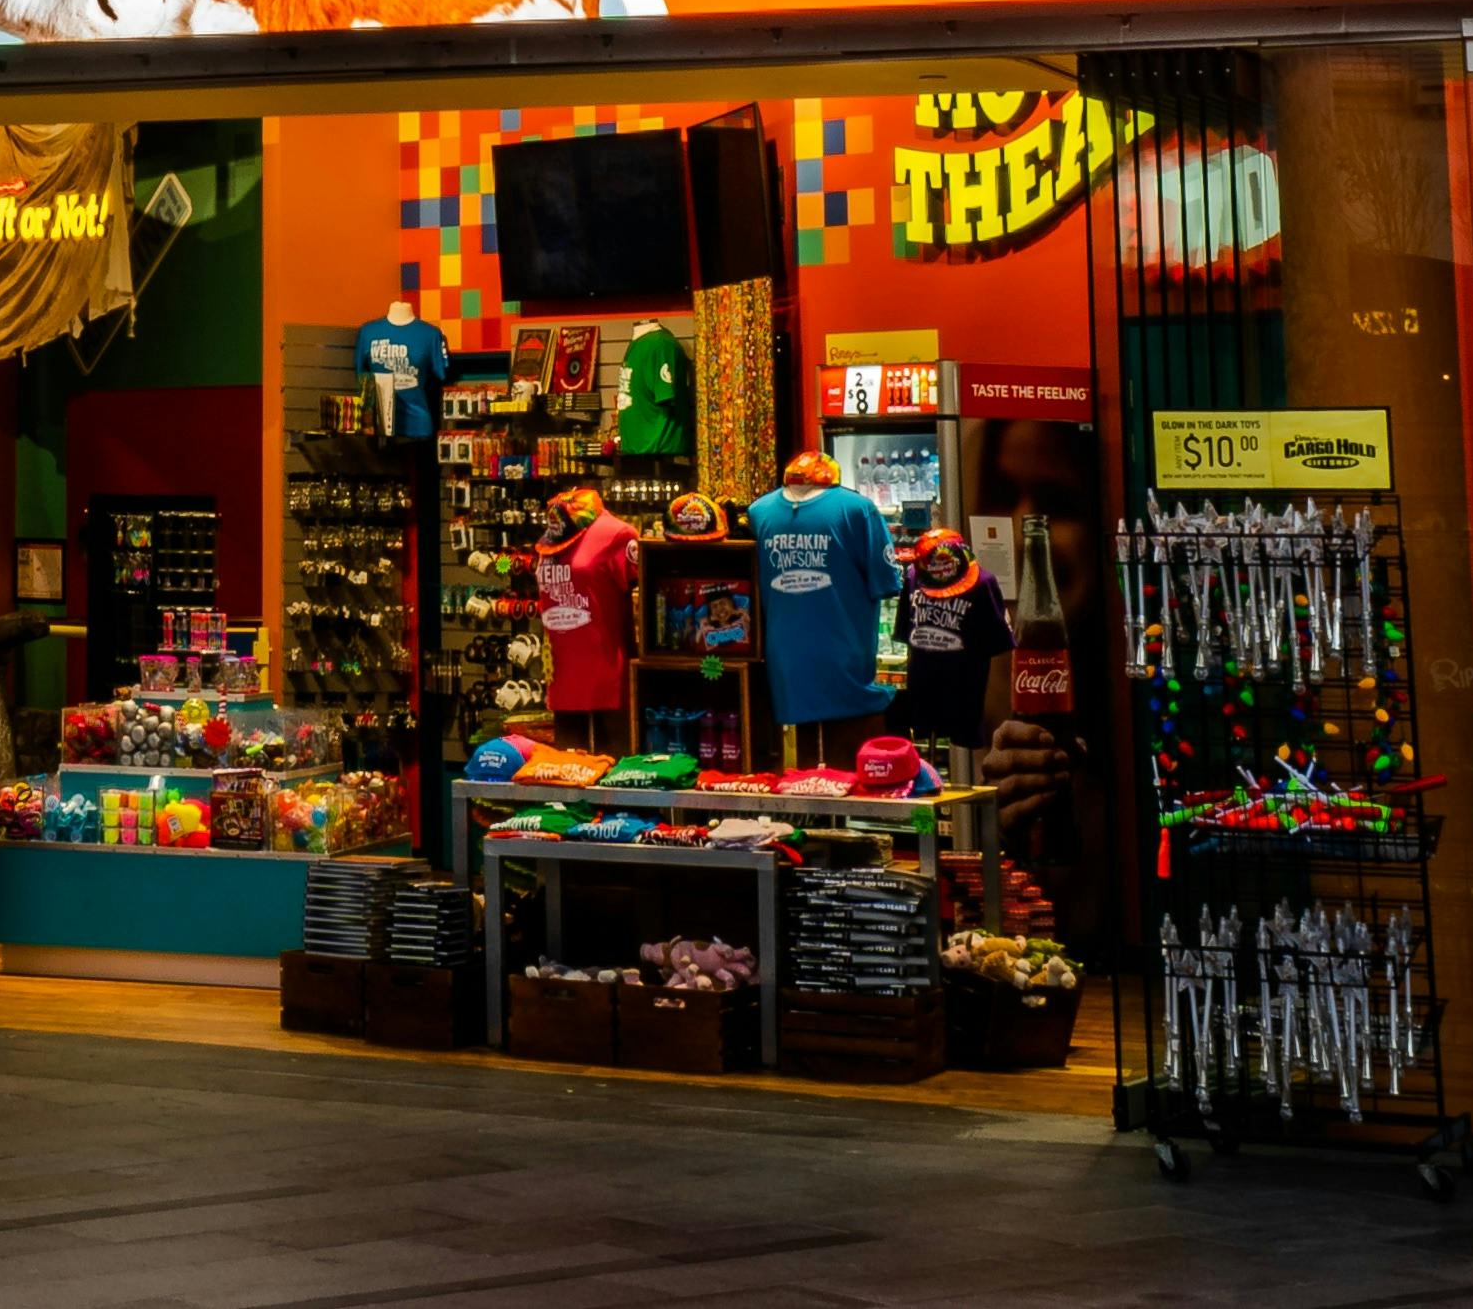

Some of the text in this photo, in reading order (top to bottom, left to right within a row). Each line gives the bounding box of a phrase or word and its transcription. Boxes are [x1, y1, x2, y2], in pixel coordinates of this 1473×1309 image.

[20, 205, 53, 240] or
[51, 190, 110, 241] Not!
[972, 384, 1087, 401] TASTE THE FEELING
[1161, 420, 1261, 430] GLOW IN THE DARK TOYS
[1283, 441, 1334, 459] CARGO
[1335, 438, 1377, 459] HOLD
